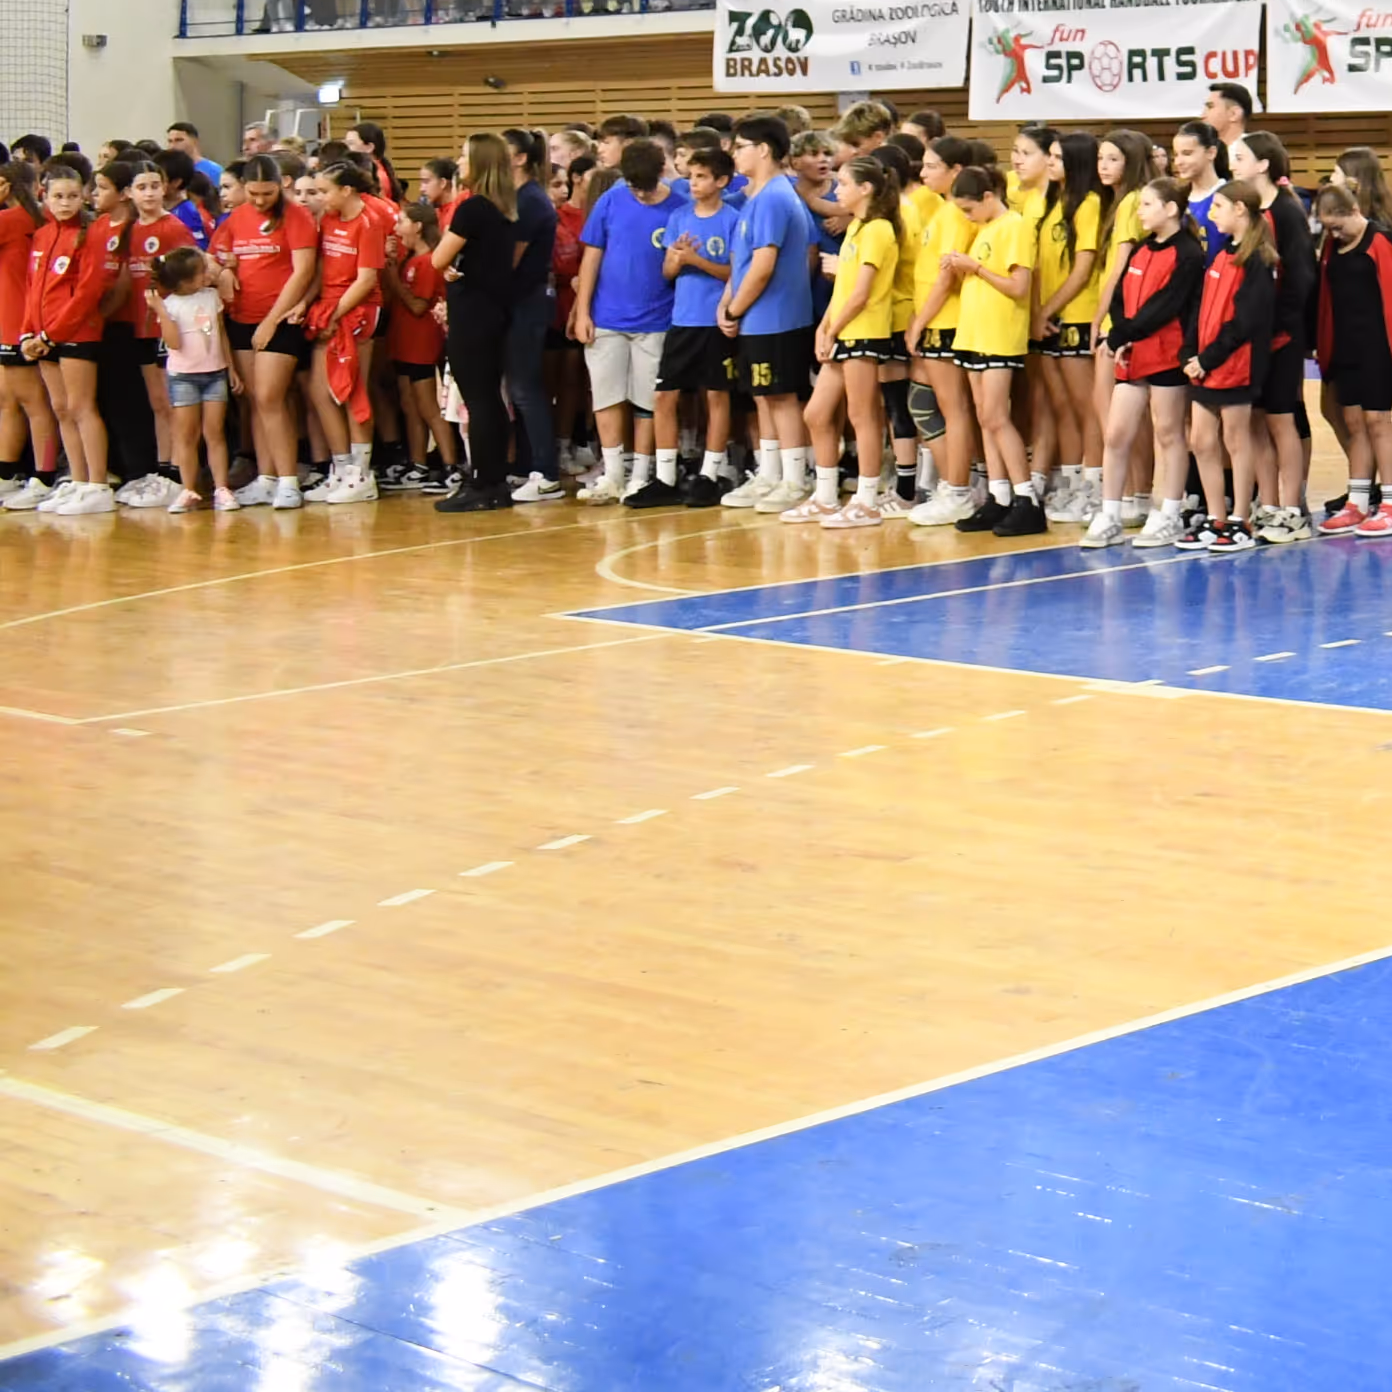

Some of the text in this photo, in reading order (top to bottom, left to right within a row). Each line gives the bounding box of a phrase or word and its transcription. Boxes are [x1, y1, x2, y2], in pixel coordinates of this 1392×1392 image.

[726, 8, 814, 54] ZOO
[1051, 23, 1087, 46] fun
[725, 56, 809, 79] BRASOV
[1203, 49, 1259, 80] CUP
